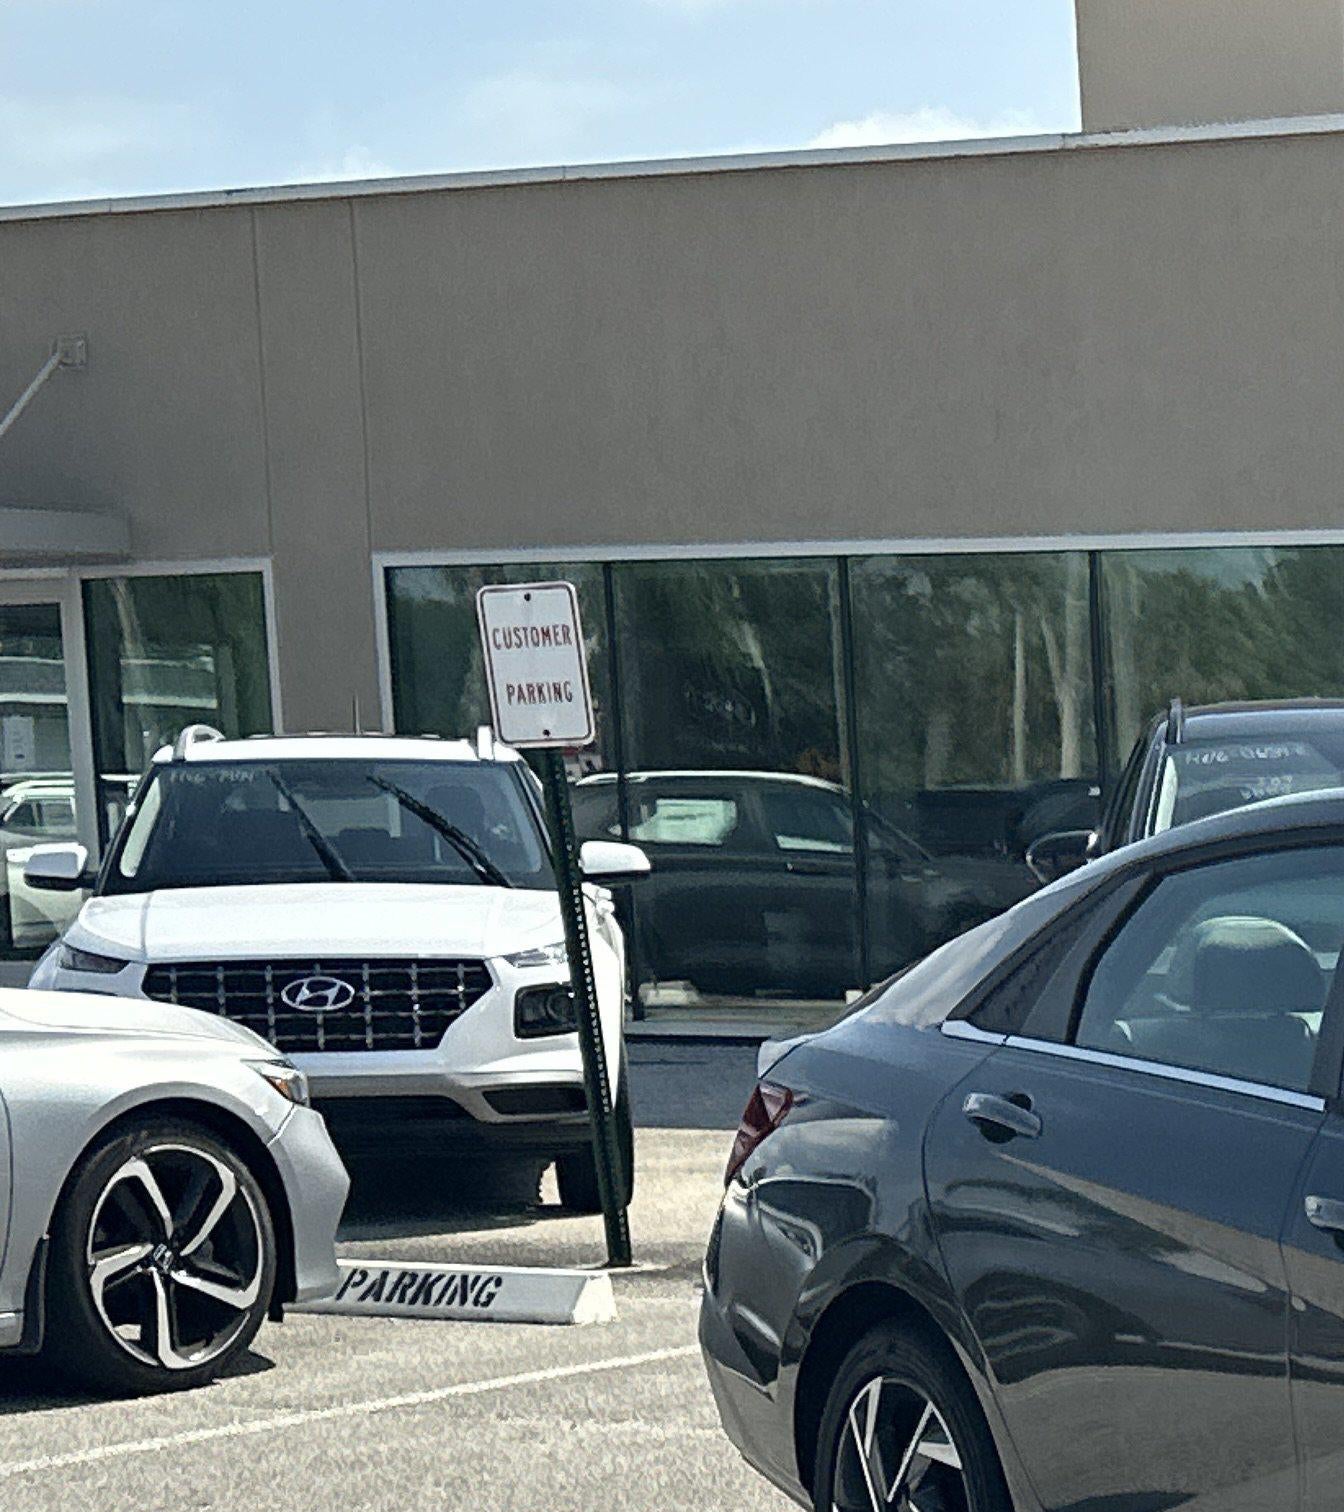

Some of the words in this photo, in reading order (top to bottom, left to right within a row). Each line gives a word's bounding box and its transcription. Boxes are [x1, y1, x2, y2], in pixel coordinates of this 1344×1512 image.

[492, 623, 573, 650] CUSTOMER
[505, 680, 573, 705] PARKING
[335, 1267, 502, 1308] PARKING
